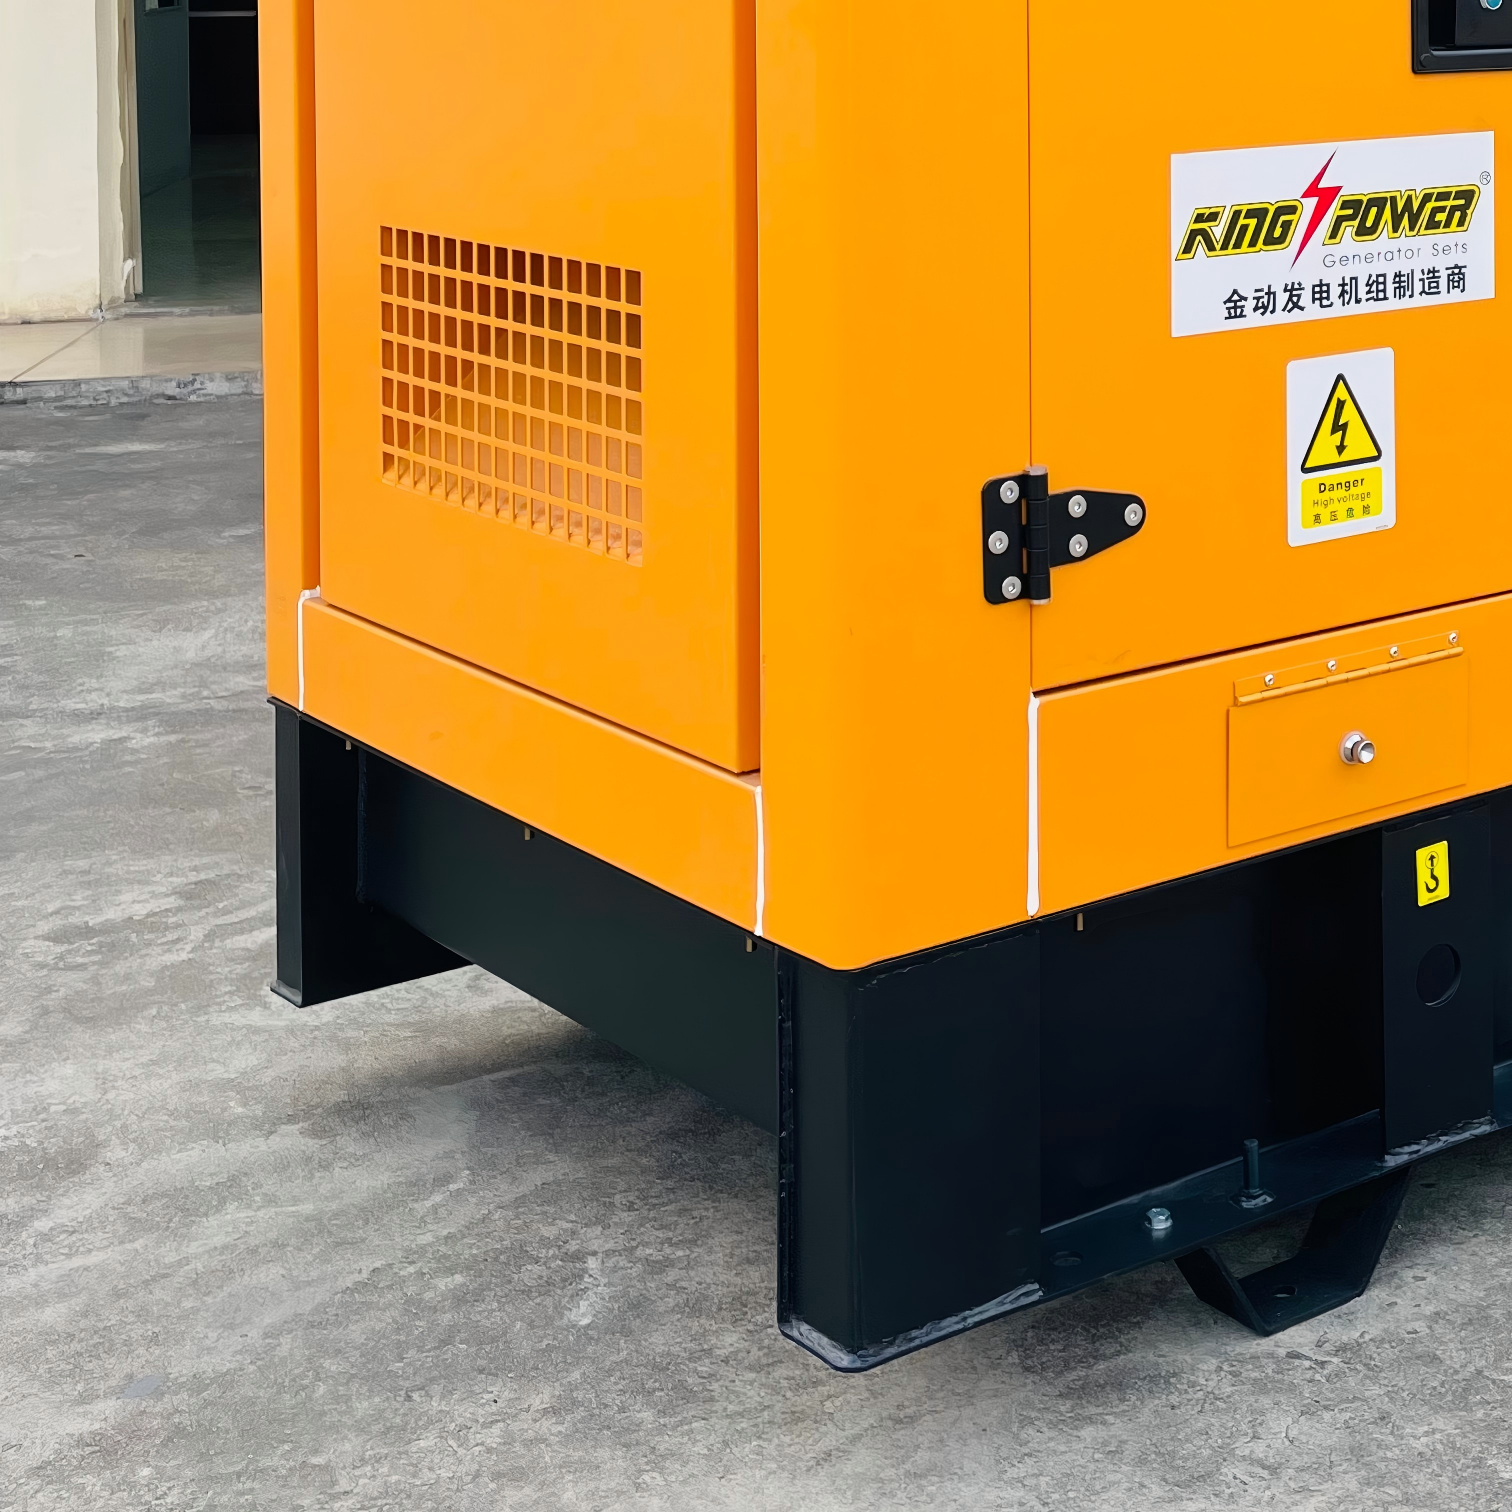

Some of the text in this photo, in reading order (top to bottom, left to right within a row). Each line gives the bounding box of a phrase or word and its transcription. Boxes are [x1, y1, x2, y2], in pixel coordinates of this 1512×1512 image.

[1175, 199, 1303, 261] KING
[1322, 183, 1481, 246] POWER
[1323, 241, 1468, 268] Generator Sets
[1223, 263, 1468, 321] 金动发电机组制造商
[1318, 477, 1365, 494] Danger
[1312, 491, 1371, 509] High voltage
